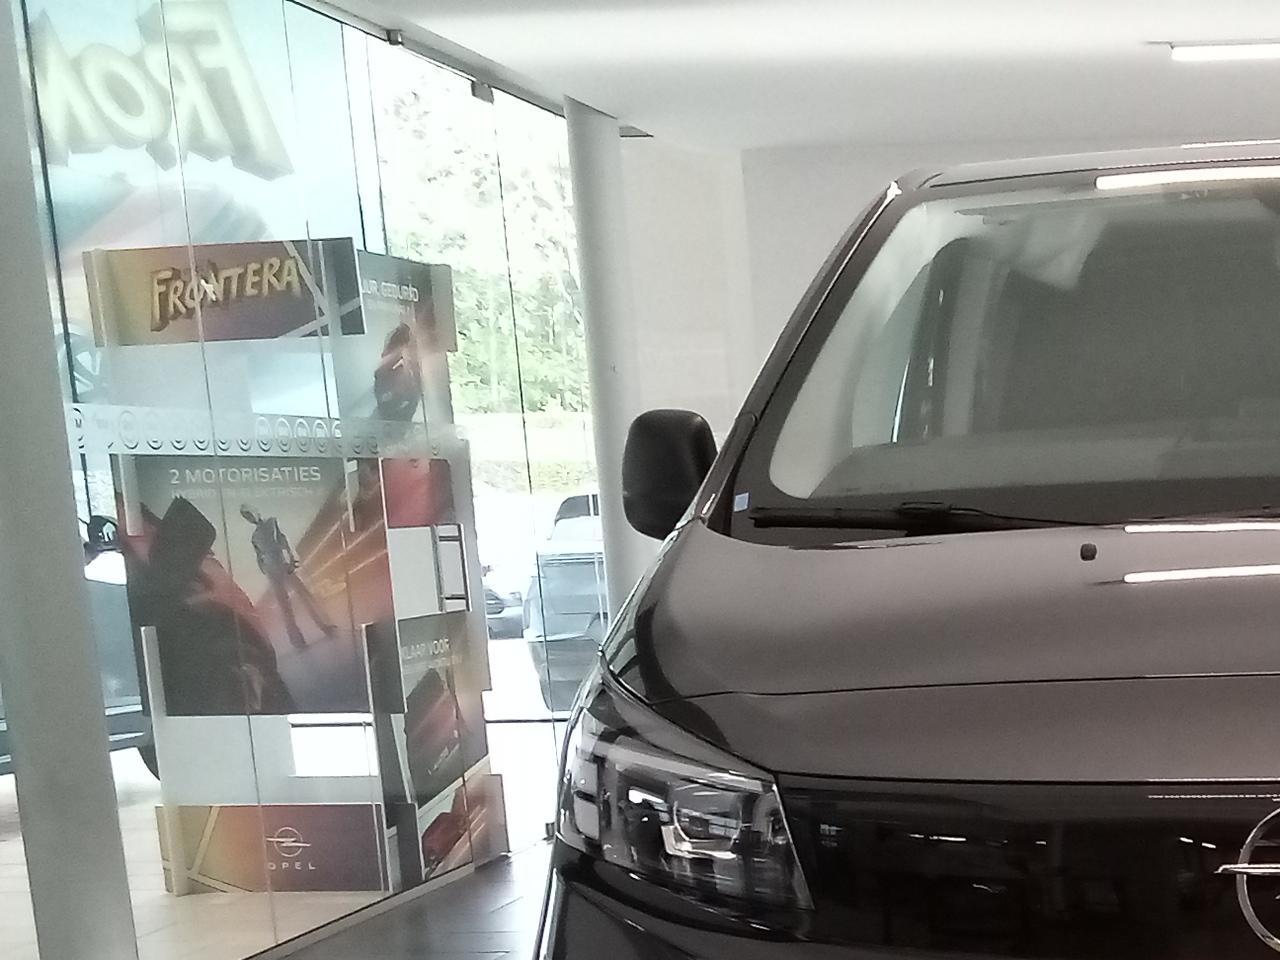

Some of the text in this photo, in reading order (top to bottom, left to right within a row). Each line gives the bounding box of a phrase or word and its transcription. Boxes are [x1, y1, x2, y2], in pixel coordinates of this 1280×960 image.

[151, 256, 300, 330] FRONTERA
[169, 466, 321, 485] 2 MOTORISATIES
[267, 861, 316, 870] OPEL
